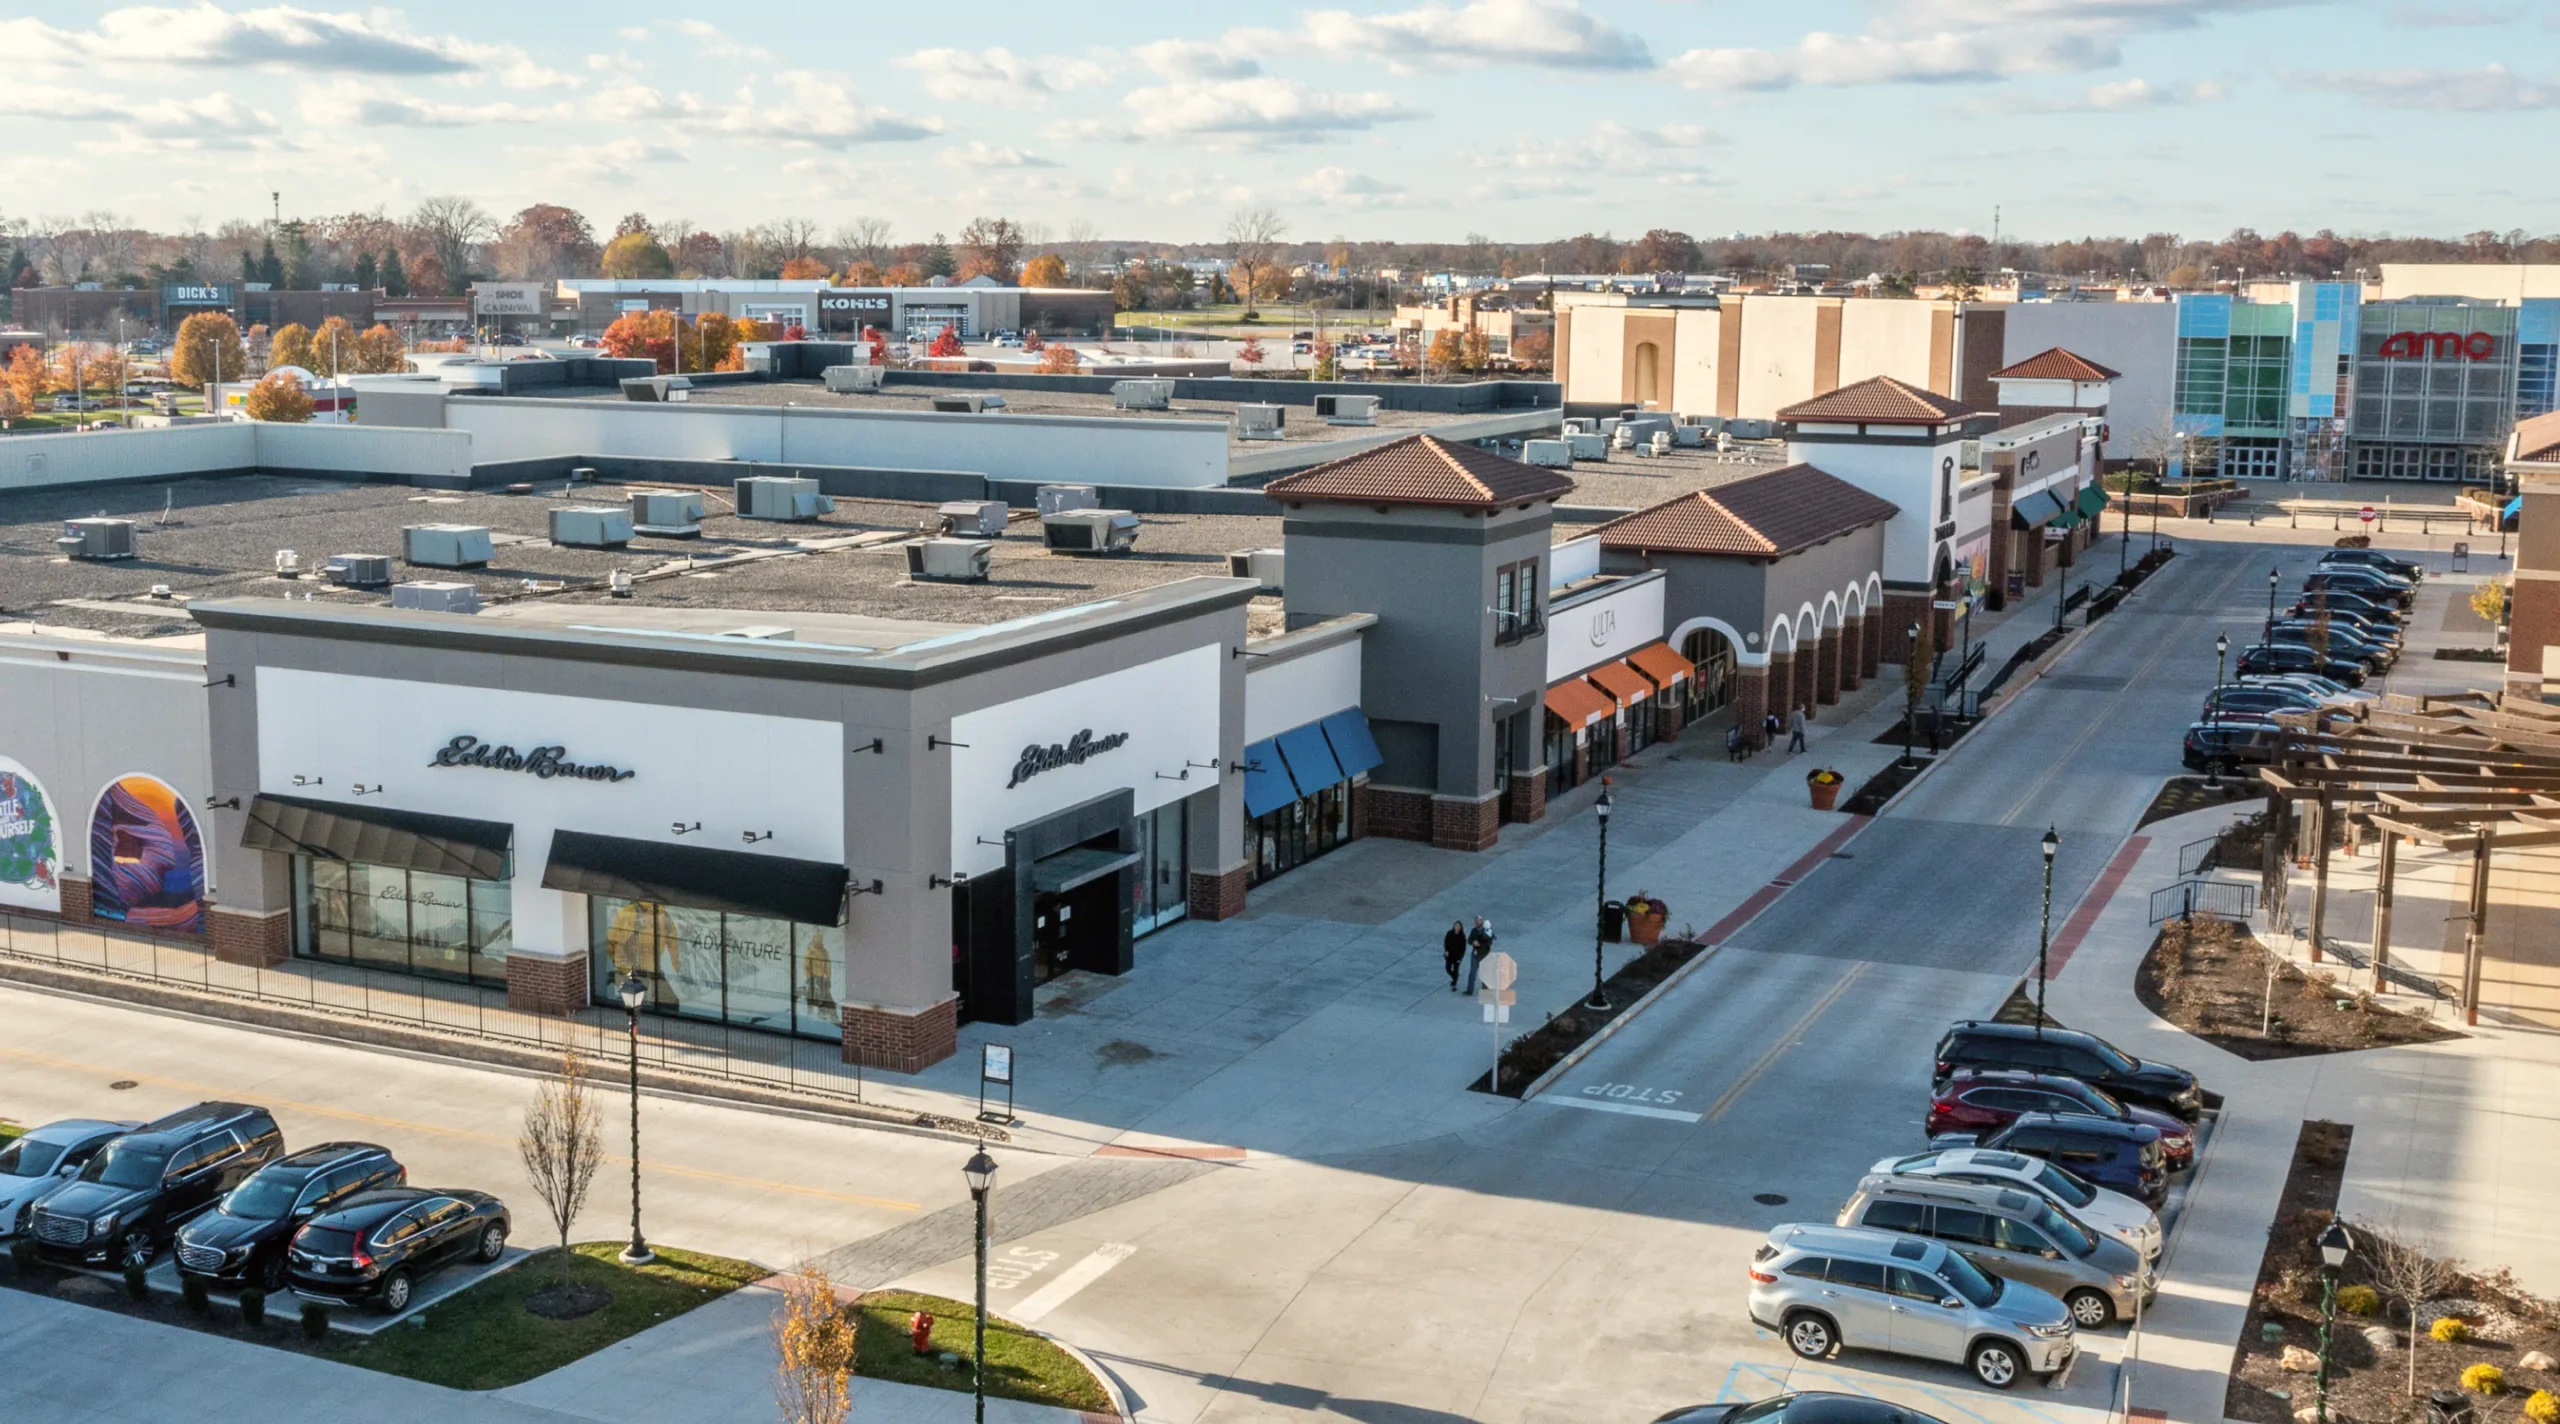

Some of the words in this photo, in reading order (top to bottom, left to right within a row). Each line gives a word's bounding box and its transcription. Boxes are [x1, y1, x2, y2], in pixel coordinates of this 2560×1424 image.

[177, 287, 219, 299] DICK'S
[495, 290, 525, 299] SHOE
[821, 298, 889, 309] KOHL'S
[1591, 609, 1617, 641] ULTA
[428, 735, 522, 771] Eddie
[524, 746, 635, 782] Bauer
[0, 819, 36, 839] URSELF
[1582, 1082, 1684, 1104] STOP
